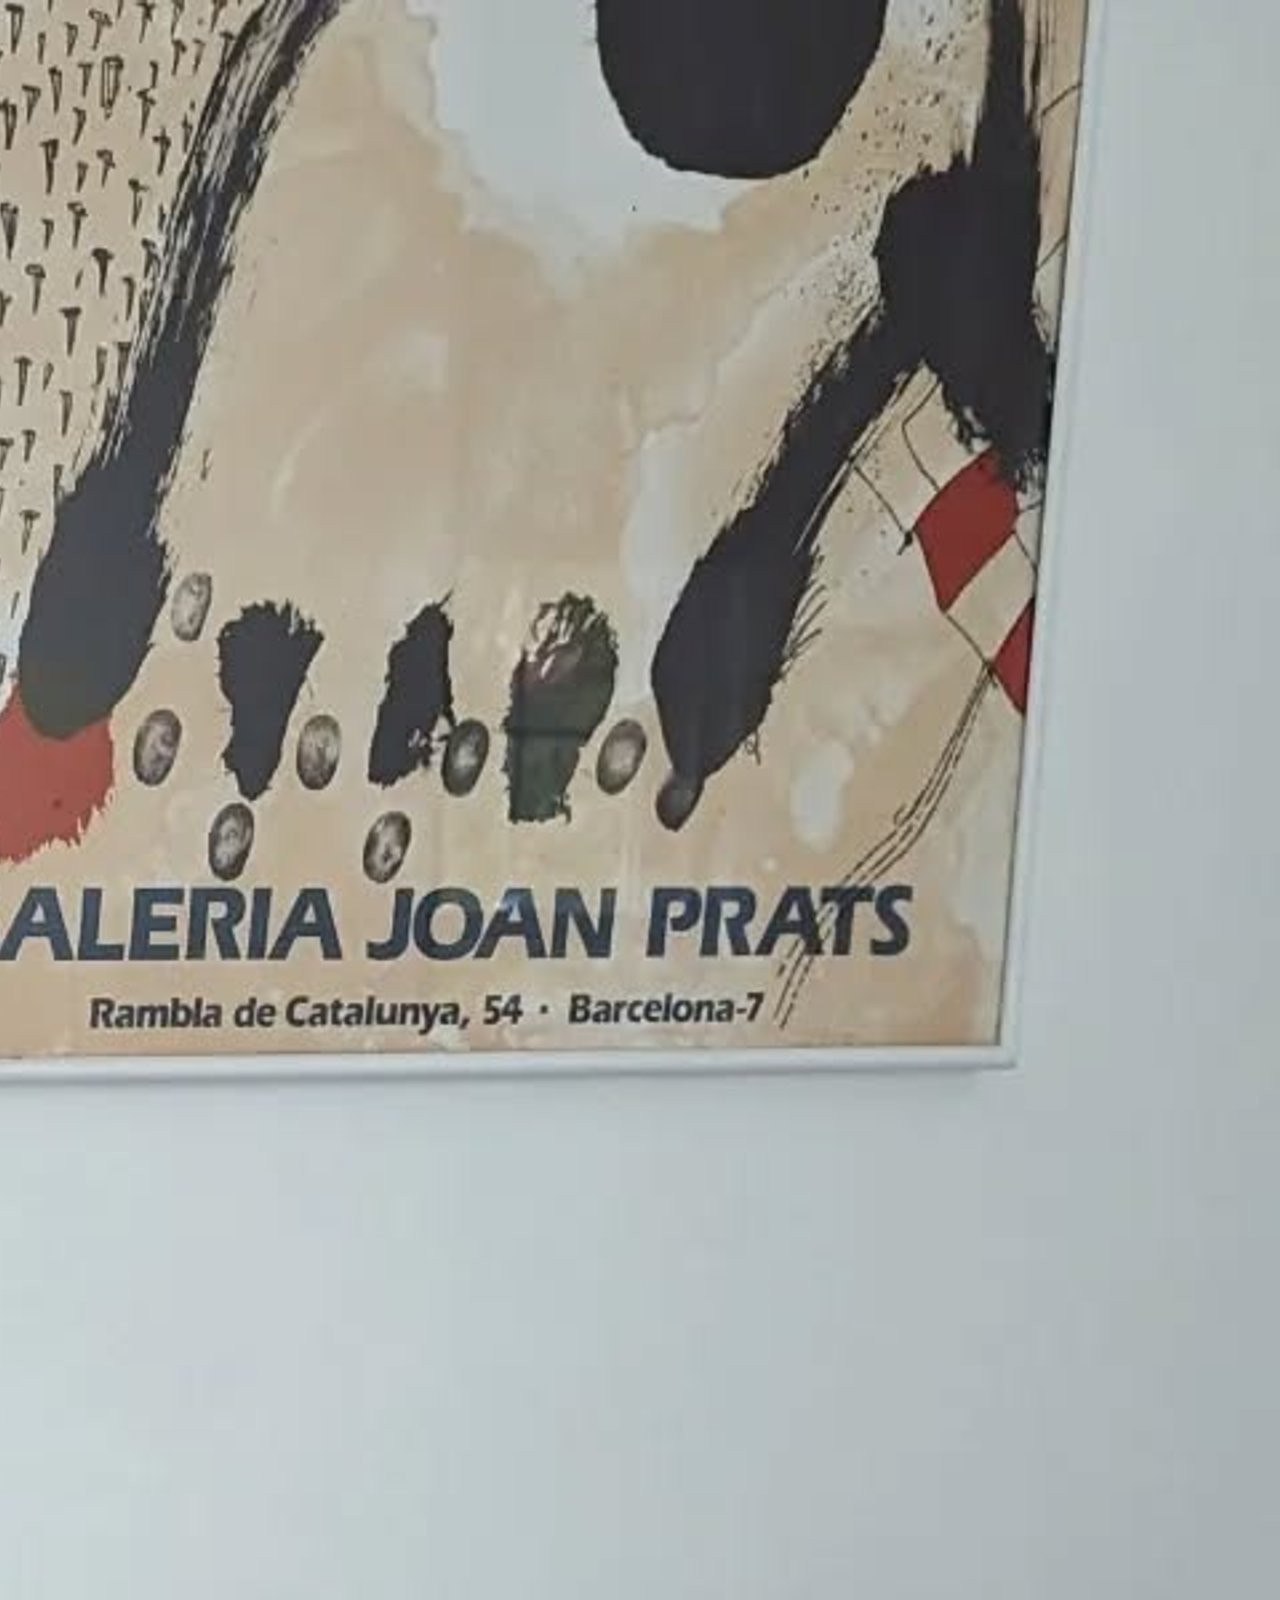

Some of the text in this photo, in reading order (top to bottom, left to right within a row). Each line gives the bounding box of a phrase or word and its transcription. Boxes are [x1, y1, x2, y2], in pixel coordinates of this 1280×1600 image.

[365, 885, 618, 962] JOAN
[645, 884, 915, 958] PRATS
[89, 992, 766, 1036] Rambla de Catalunya, 54 Barcelona-7
